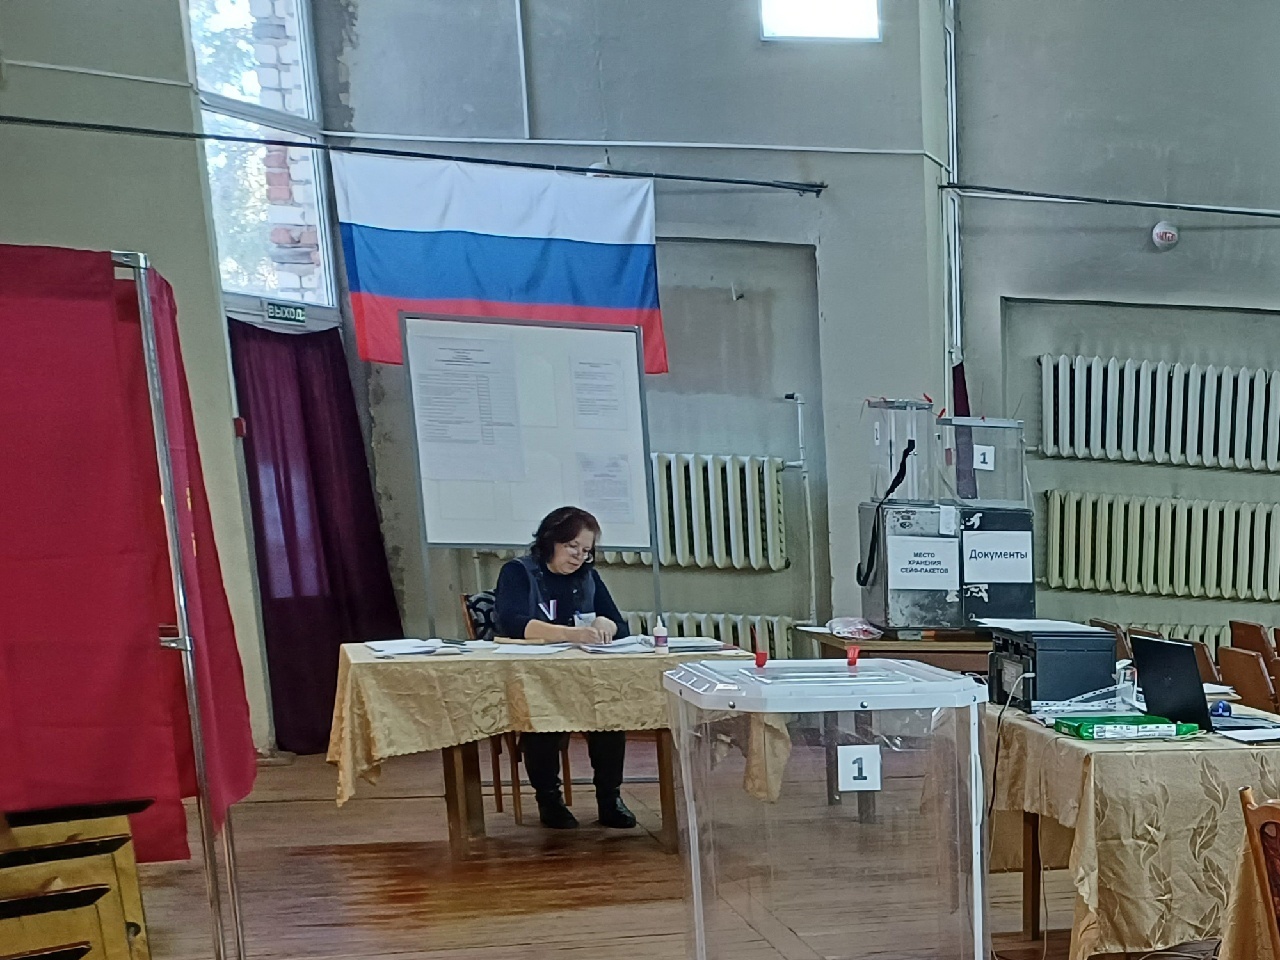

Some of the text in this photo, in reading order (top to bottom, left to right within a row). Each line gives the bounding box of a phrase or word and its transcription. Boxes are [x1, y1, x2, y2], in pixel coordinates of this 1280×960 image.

[268, 304, 305, 320] ВЫХОД
[980, 451, 989, 465] 1
[969, 549, 1028, 561] Документы
[852, 757, 868, 780] 1
